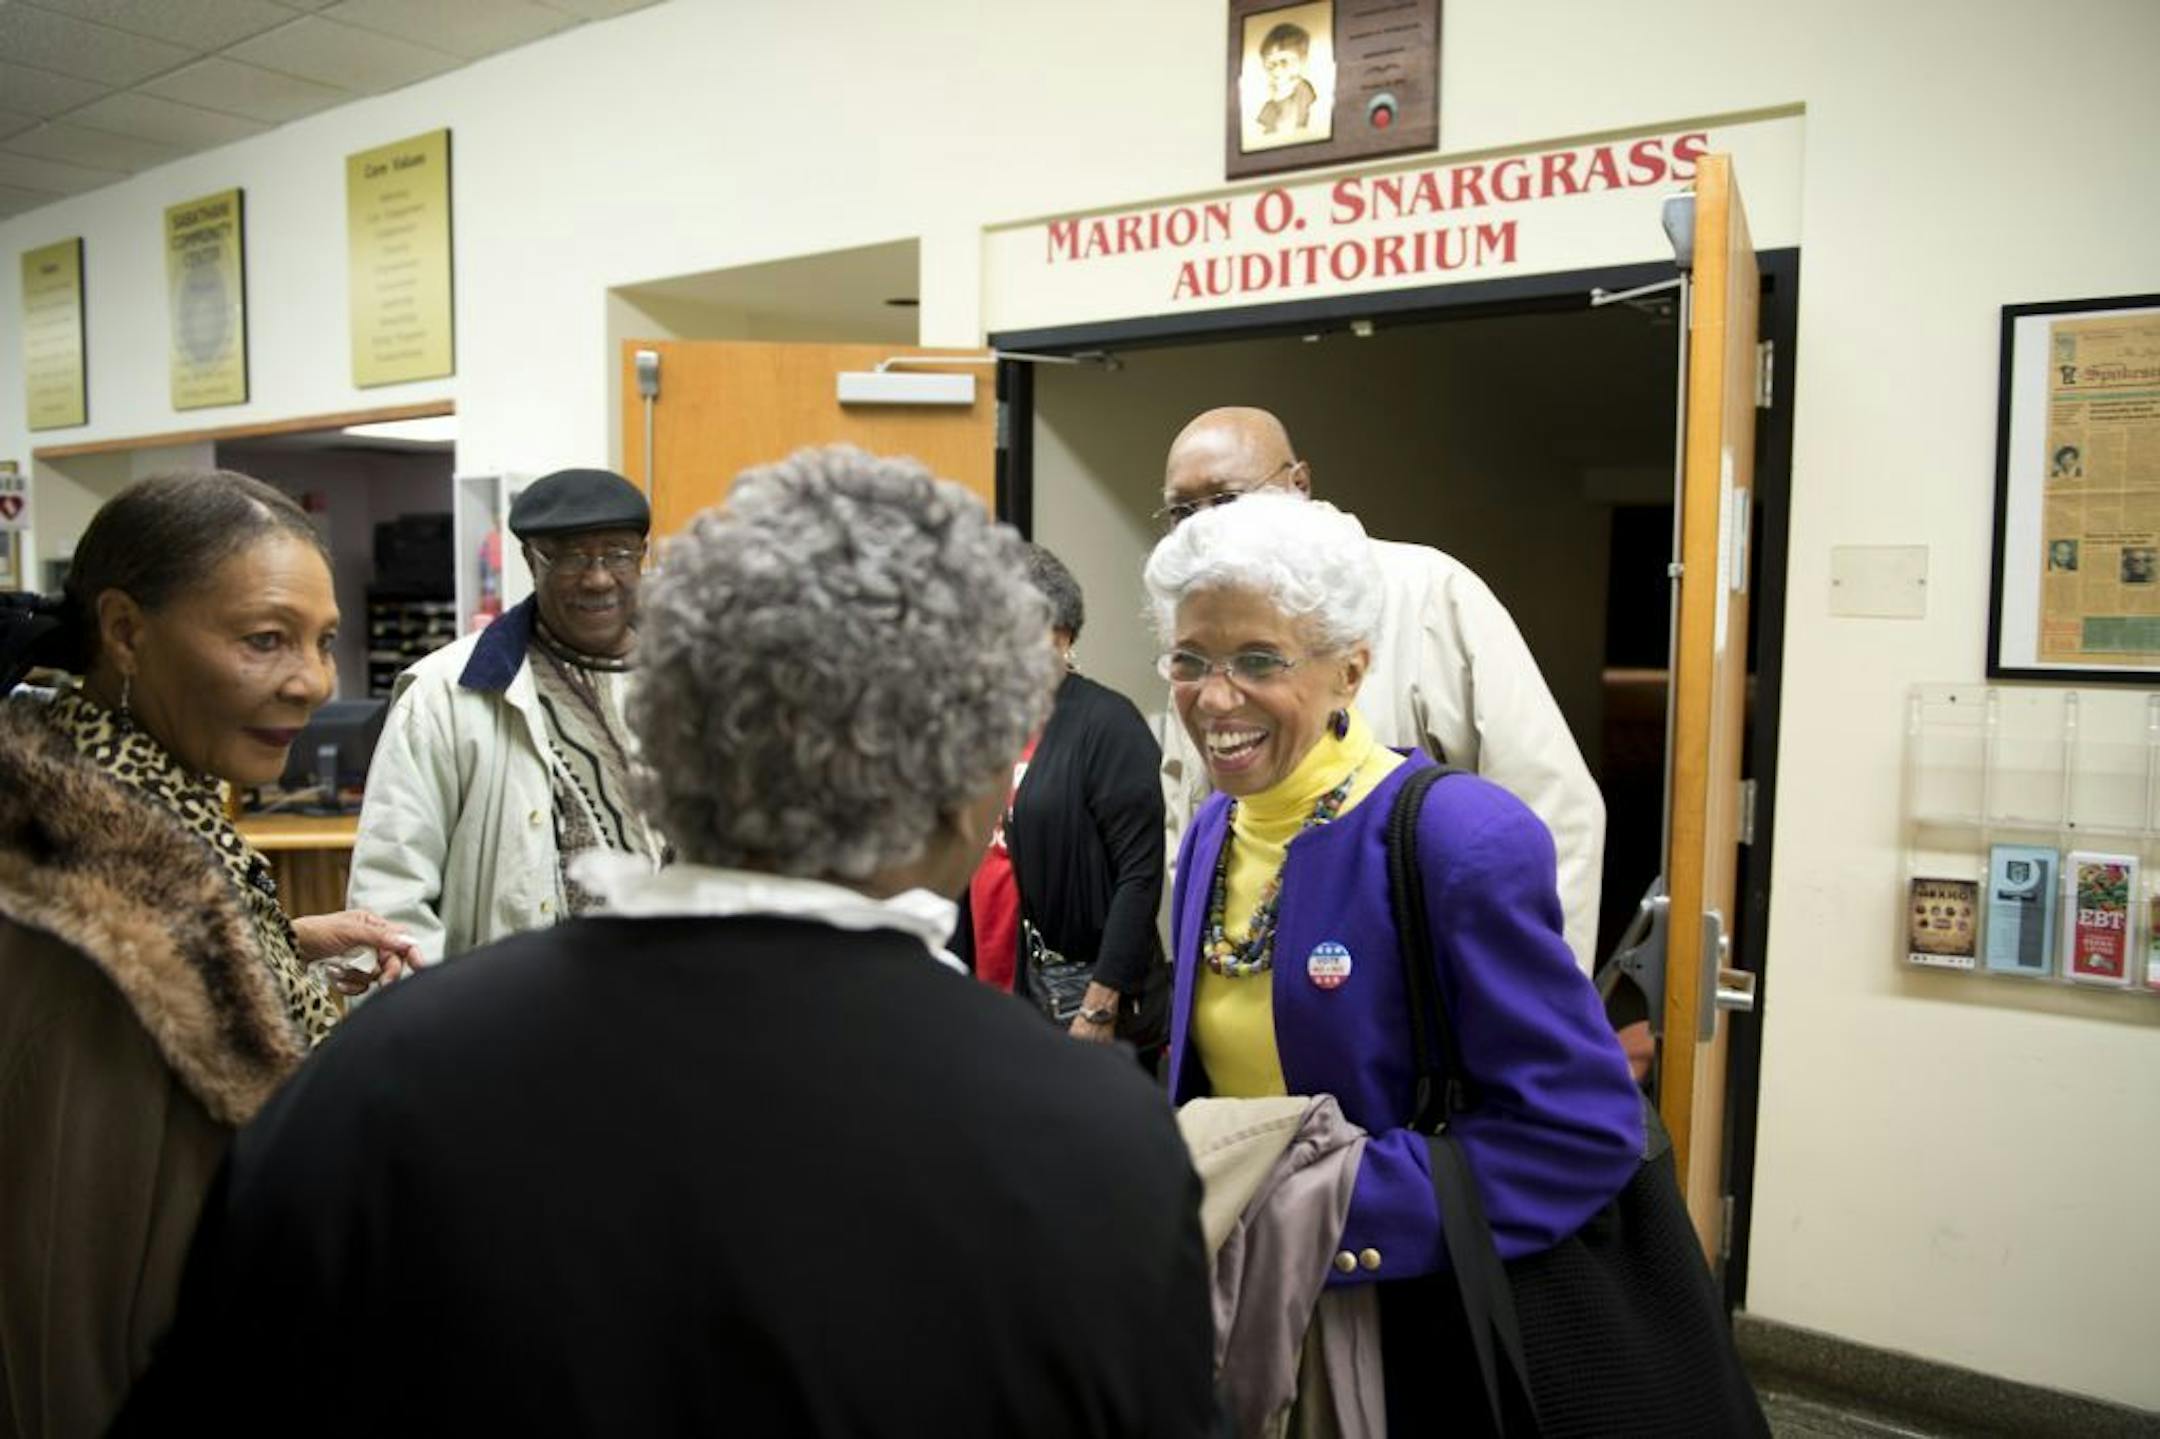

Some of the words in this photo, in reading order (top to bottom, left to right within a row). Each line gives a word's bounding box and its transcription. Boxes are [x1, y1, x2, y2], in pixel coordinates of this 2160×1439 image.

[1046, 202, 1232, 263] MARION
[1254, 187, 1306, 236] O.
[1331, 133, 1709, 224] SNARGRASS
[1172, 221, 1518, 300] AUDITORIUM
[2079, 909, 2125, 930] EBT
